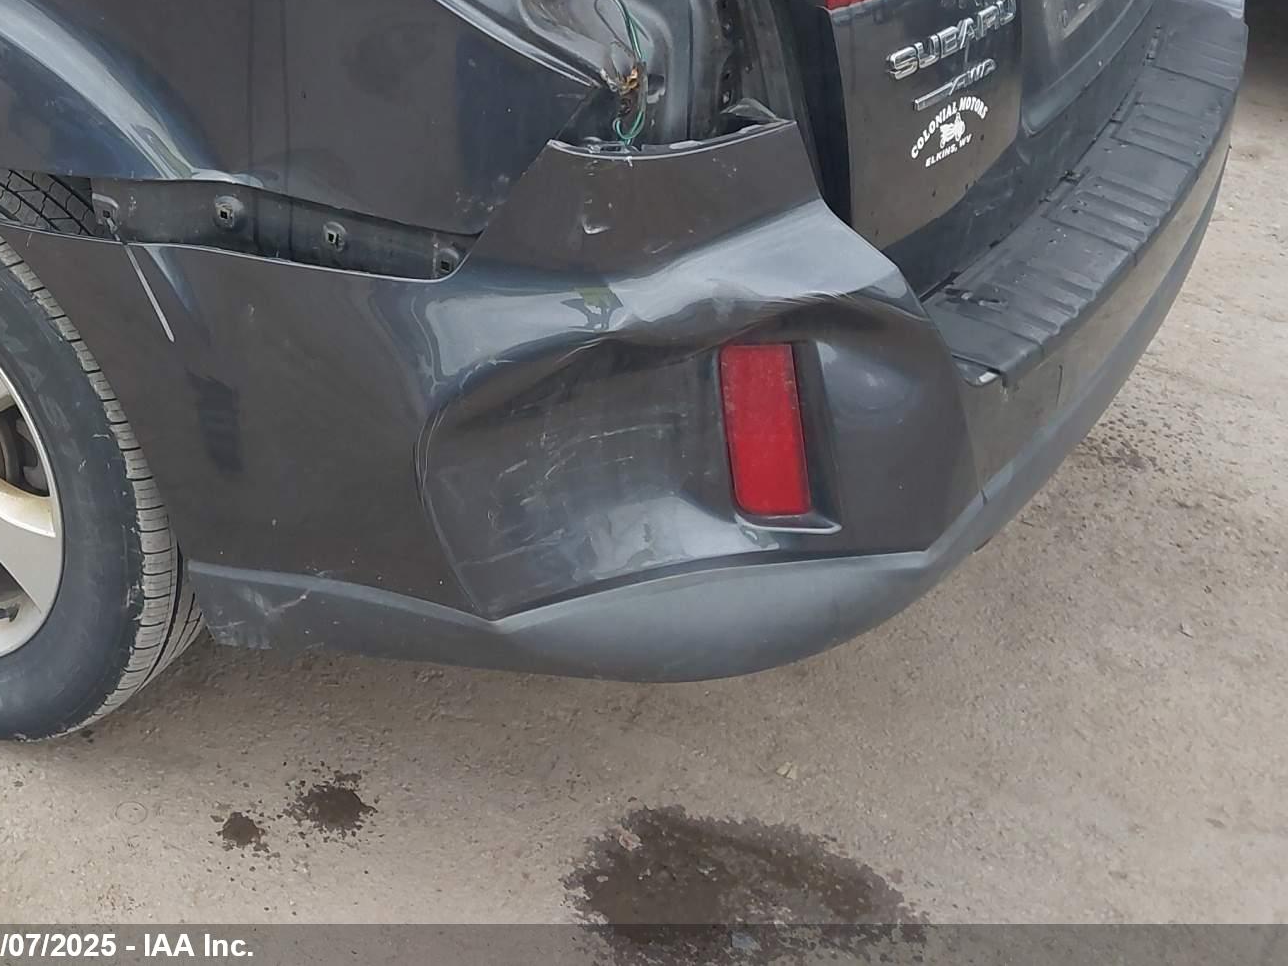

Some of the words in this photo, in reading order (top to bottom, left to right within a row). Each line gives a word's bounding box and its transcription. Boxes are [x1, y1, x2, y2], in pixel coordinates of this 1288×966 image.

[911, 101, 958, 159] COLONIAL
[958, 96, 989, 119] MOTORS
[925, 144, 958, 168] ELKINS,
[959, 133, 972, 148] WV
